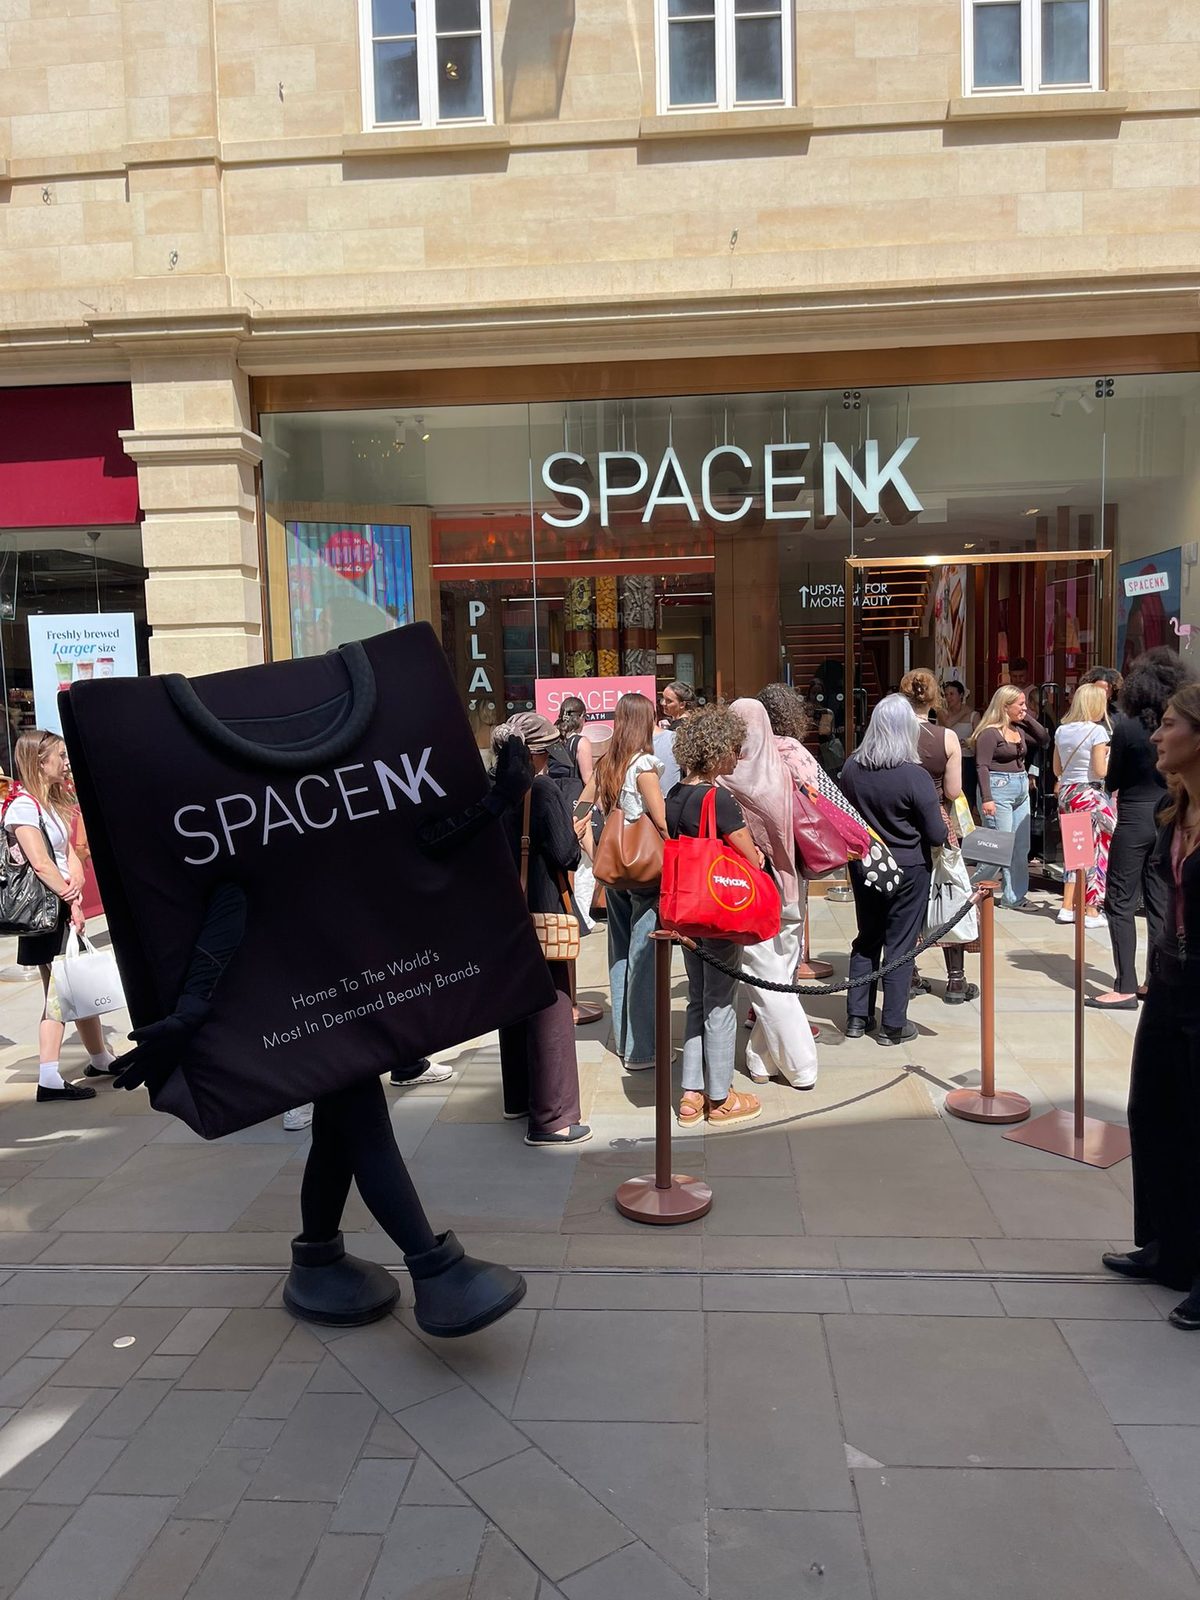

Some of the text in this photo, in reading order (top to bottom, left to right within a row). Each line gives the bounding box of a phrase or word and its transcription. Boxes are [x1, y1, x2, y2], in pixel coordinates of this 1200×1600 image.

[541, 437, 925, 528] SPACENK
[810, 583, 888, 596] UPSTA FOR
[1128, 576, 1166, 592] SPACENK
[809, 596, 893, 608] MORE AUTY
[46, 629, 120, 641] Freshly brewed
[98, 643, 117, 653] size
[468, 600, 493, 697] PLA
[173, 746, 448, 865] SPACENK
[291, 949, 441, 1010] Home To The World's
[94, 996, 112, 1007] COS
[262, 961, 482, 1049] Most In Demand Beauty Brands
